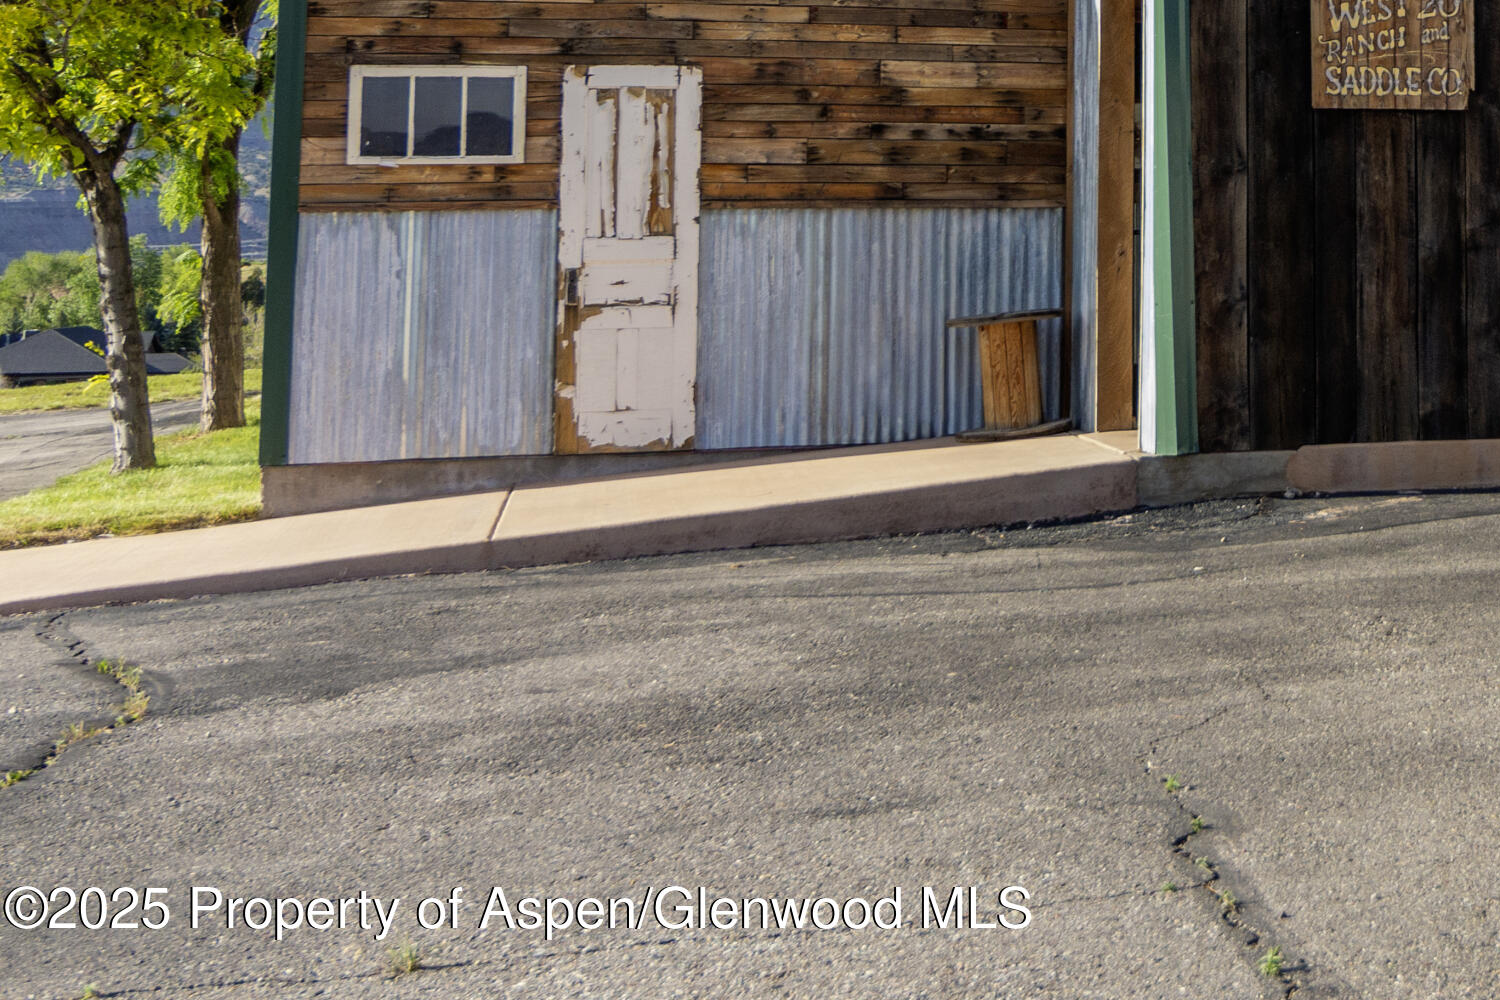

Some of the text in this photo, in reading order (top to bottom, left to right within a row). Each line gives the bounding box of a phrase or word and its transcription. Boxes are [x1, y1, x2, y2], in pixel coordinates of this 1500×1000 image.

[1318, 21, 1450, 64] RANCH and
[1325, 66, 1464, 96] SADDLE CO.
